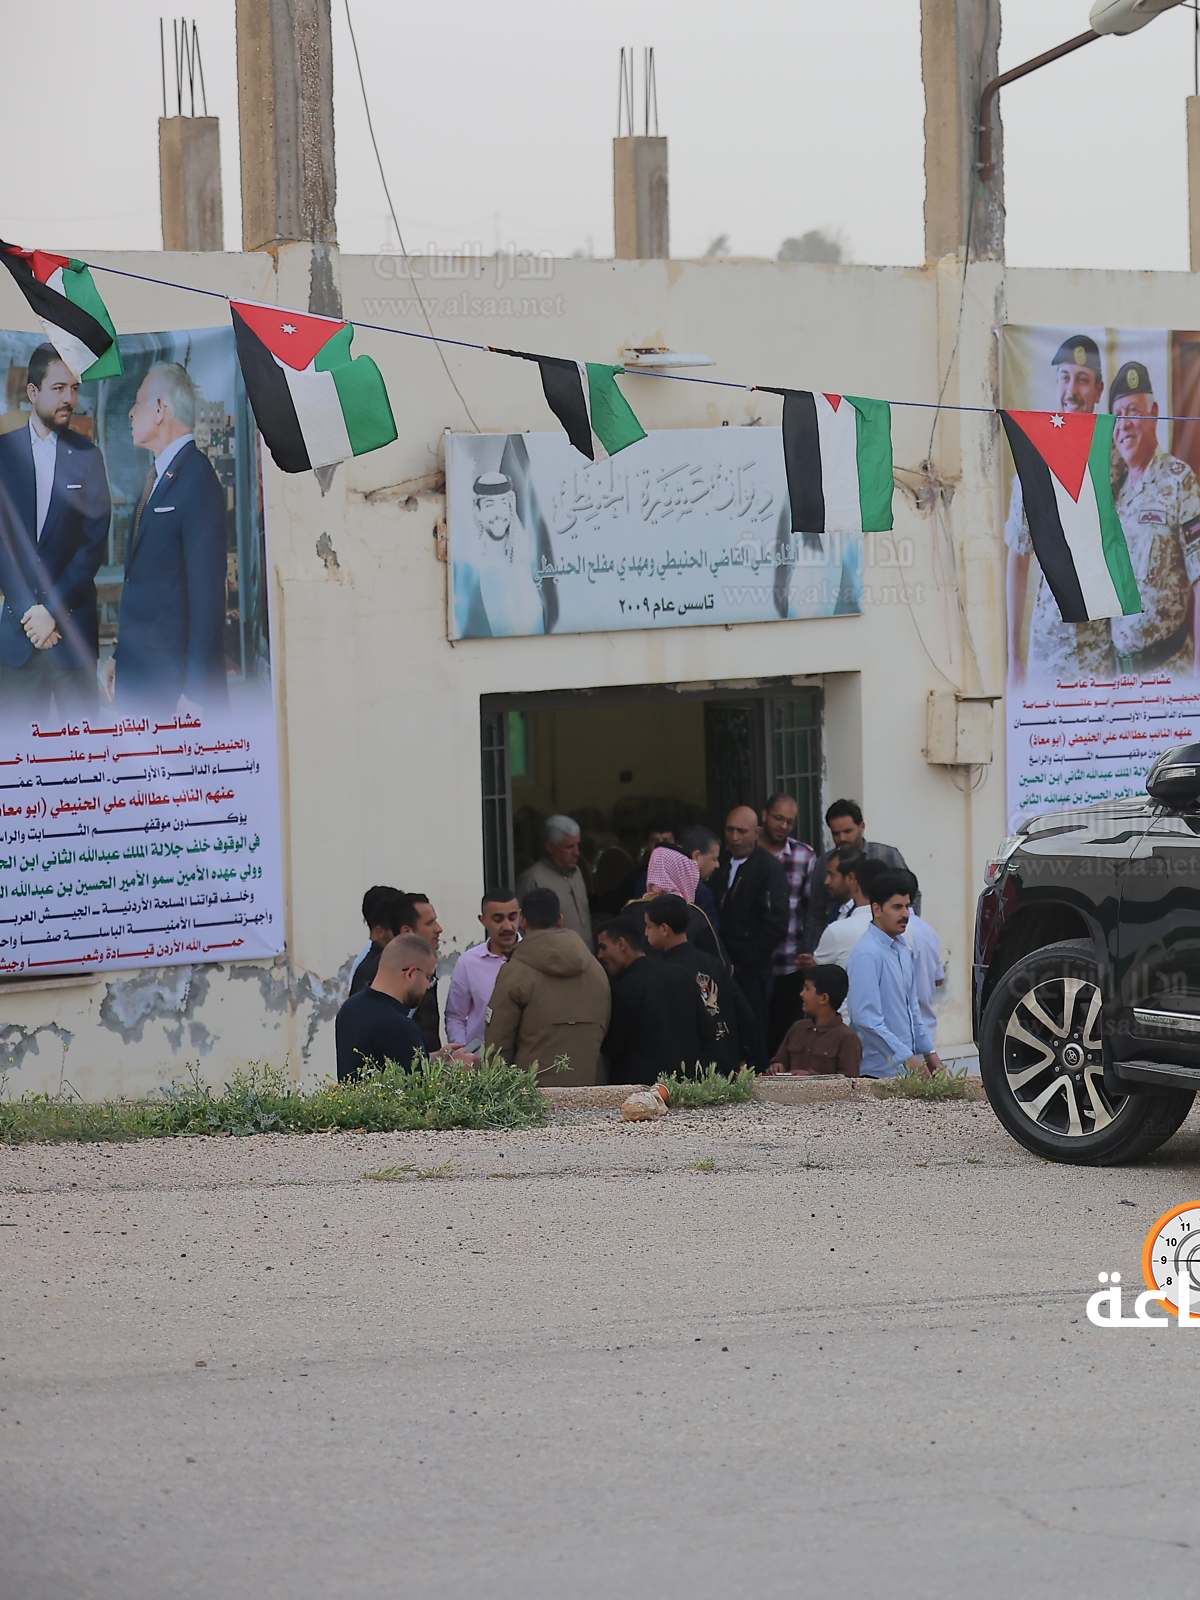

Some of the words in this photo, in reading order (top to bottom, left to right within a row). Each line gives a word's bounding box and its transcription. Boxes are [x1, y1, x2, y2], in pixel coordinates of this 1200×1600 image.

[587, 554, 614, 584] مفلح
[617, 555, 654, 581] ومهدي
[656, 552, 706, 577] الحنيطي
[709, 549, 749, 574] القاضي
[752, 547, 775, 576] علي
[533, 555, 585, 588] الحنيطي
[619, 598, 650, 614] ٢٠٠٩
[653, 598, 675, 618] عام
[1057, 677, 1088, 689] عامة
[1090, 674, 1137, 690] البلقاوية
[1138, 674, 1171, 688] عشائر
[1023, 700, 1051, 709] خاصة
[150, 713, 201, 734] عشائر
[1058, 714, 1105, 724] العاصمة
[32, 723, 80, 740] عامة
[80, 719, 149, 737] البلقاوية
[1149, 729, 1172, 741] النائب
[1174, 727, 1192, 740] عنهم
[1068, 732, 1101, 747] الحنيطي
[1103, 732, 1117, 745] علي
[88, 746, 110, 762] أبو
[112, 738, 192, 763] وأهالي
[194, 739, 250, 755] والحنيطيين
[27, 750, 85, 764] علندا
[110, 764, 160, 784] الأولى
[162, 764, 210, 780] الدائرة
[210, 758, 259, 777] وأبناء
[1086, 770, 1113, 781] عبدالله
[1115, 768, 1132, 777] الملك
[36, 772, 105, 786] العاصمة
[1019, 773, 1046, 787] الحسين
[1048, 773, 1063, 785] ابن
[1064, 769, 1085, 785] الثاني
[172, 786, 203, 807] النائب
[205, 784, 235, 804] عنهم
[1019, 793, 1042, 810] الثاني
[1044, 791, 1071, 805] عبدالله
[1072, 793, 1083, 804] بن
[1084, 790, 1111, 803] الحسين
[0, 803, 22, 816] معا
[50, 797, 100, 818] الحنيطي
[104, 796, 126, 815] علي
[92, 818, 170, 838] موقفهم
[174, 813, 247, 831] يؤكدون
[28, 823, 89, 842] الثابت
[150, 842, 184, 858] جلالة
[186, 838, 211, 853] خلف
[213, 835, 247, 854] الوقوف
[248, 833, 260, 853] في
[79, 846, 120, 864] عبدالله
[123, 844, 148, 859] الملك
[19, 852, 40, 872] ابن
[42, 849, 76, 872] الثاني
[177, 864, 209, 887] الأمين
[211, 868, 237, 882] عهده
[239, 863, 262, 882] وولي
[76, 876, 116, 895] الحسين
[118, 870, 149, 892] الأمير
[151, 876, 174, 889] سمو
[11, 880, 54, 899] عبدالله
[57, 882, 72, 898] بن
[220, 889, 254, 903] وخلف
[102, 898, 151, 915] الأردنية
[155, 897, 187, 908] المسلحة
[189, 892, 218, 907] قواتنا
[0, 910, 36, 926] العرب
[38, 906, 90, 924] الجيش
[193, 909, 272, 928] وأجهزتنا
[64, 925, 125, 940] الباسلة
[128, 916, 190, 934] الأمنية
[157, 940, 184, 957] الأردن
[186, 938, 200, 950] الله
[202, 938, 244, 952] حمى
